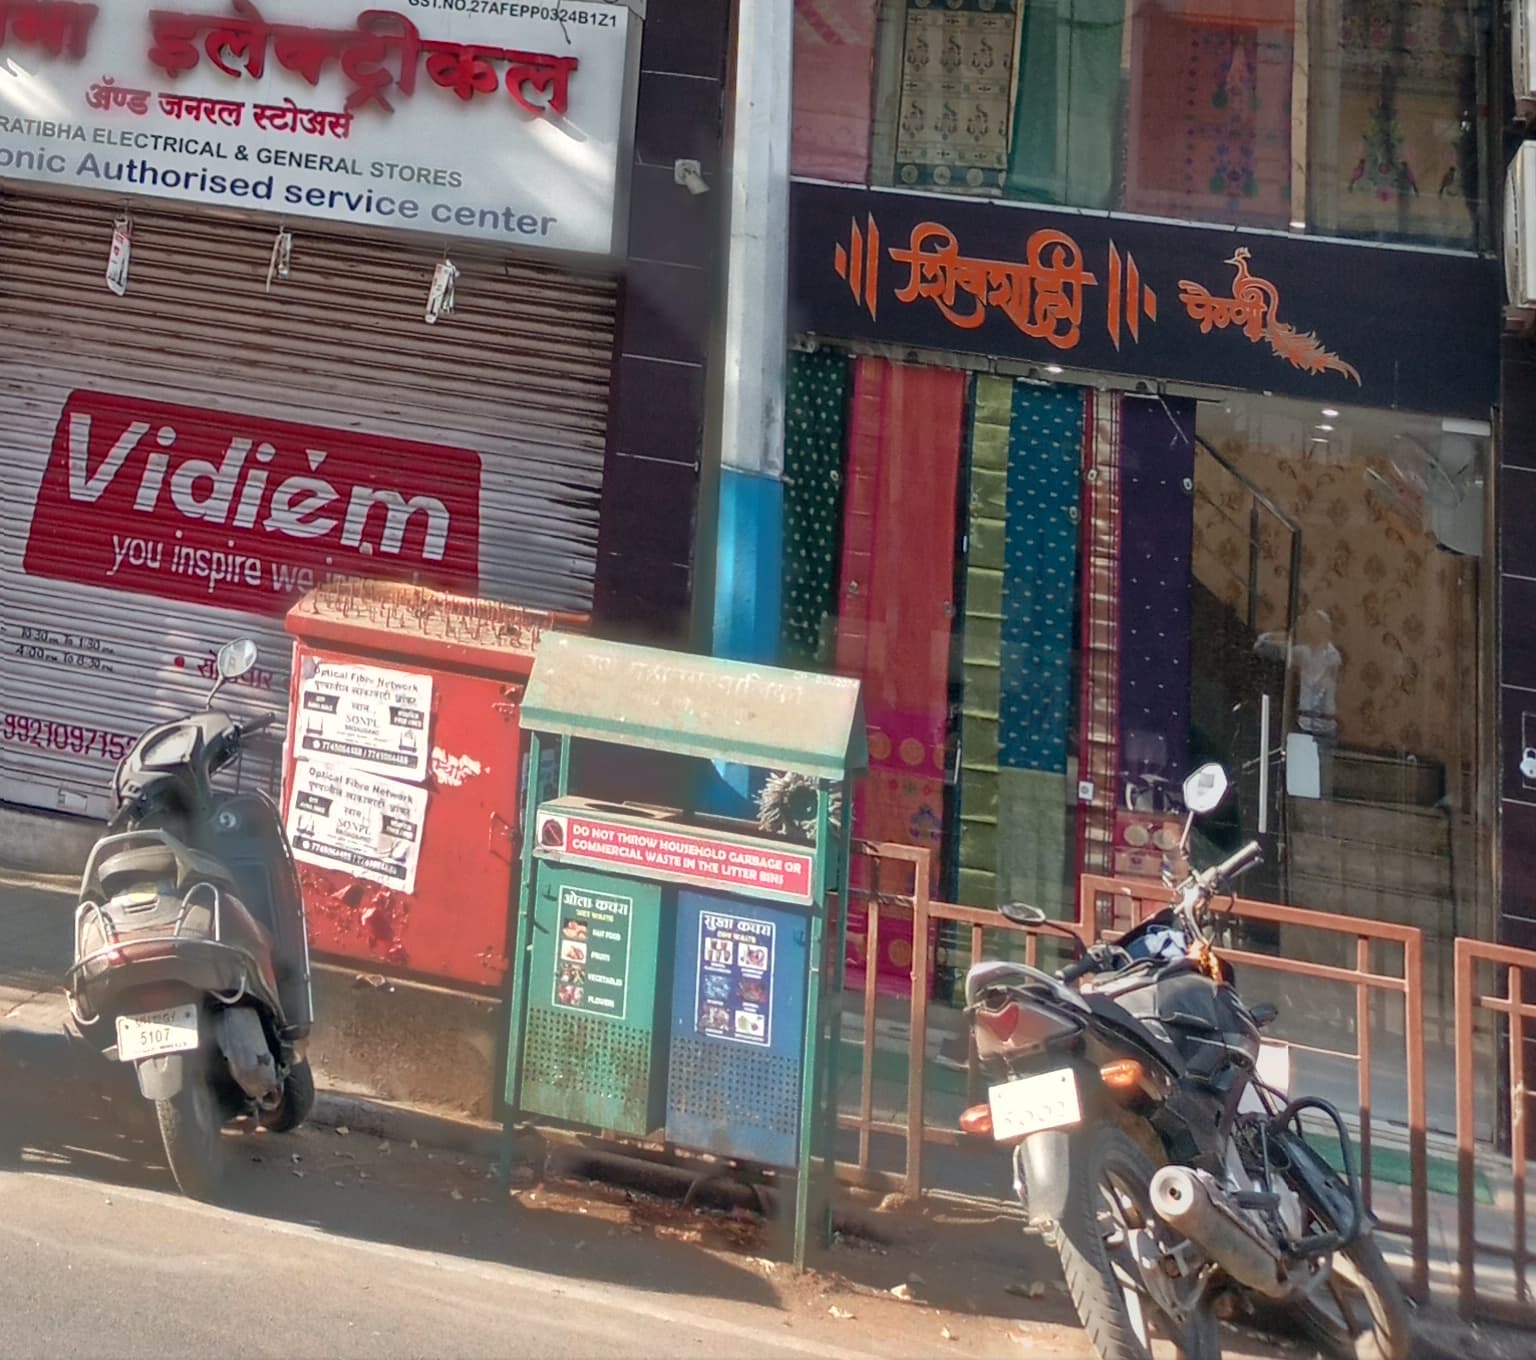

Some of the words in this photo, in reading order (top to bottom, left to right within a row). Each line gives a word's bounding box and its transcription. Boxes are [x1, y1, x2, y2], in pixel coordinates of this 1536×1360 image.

[158, 92, 246, 127] जनरल
[93, 127, 228, 158] ELECTRICAL
[234, 145, 250, 161] &
[257, 148, 363, 175] GENERAL
[370, 161, 463, 188] STORES
[76, 152, 275, 201] Authorised
[284, 181, 420, 218] service
[431, 202, 558, 237] center
[889, 221, 1099, 349] शिवशाही
[106, 534, 162, 576] you
[170, 530, 262, 593] inspire
[270, 562, 315, 593] we
[308, 767, 343, 783] Optical
[345, 777, 370, 790] Fibre
[372, 784, 414, 804] Network
[572, 823, 590, 838] DO
[592, 827, 615, 841] NOT
[617, 831, 658, 849] THROW
[659, 839, 727, 861] HOUSEHOLD
[728, 850, 782, 871] GARBAGE
[784, 861, 802, 875] OR
[572, 838, 643, 860] COMMERCIAL
[645, 849, 681, 867] WASTE
[683, 856, 695, 869] IN
[698, 860, 719, 874] THE
[721, 864, 757, 881] LITTER
[140, 1027, 171, 1046] 5107
